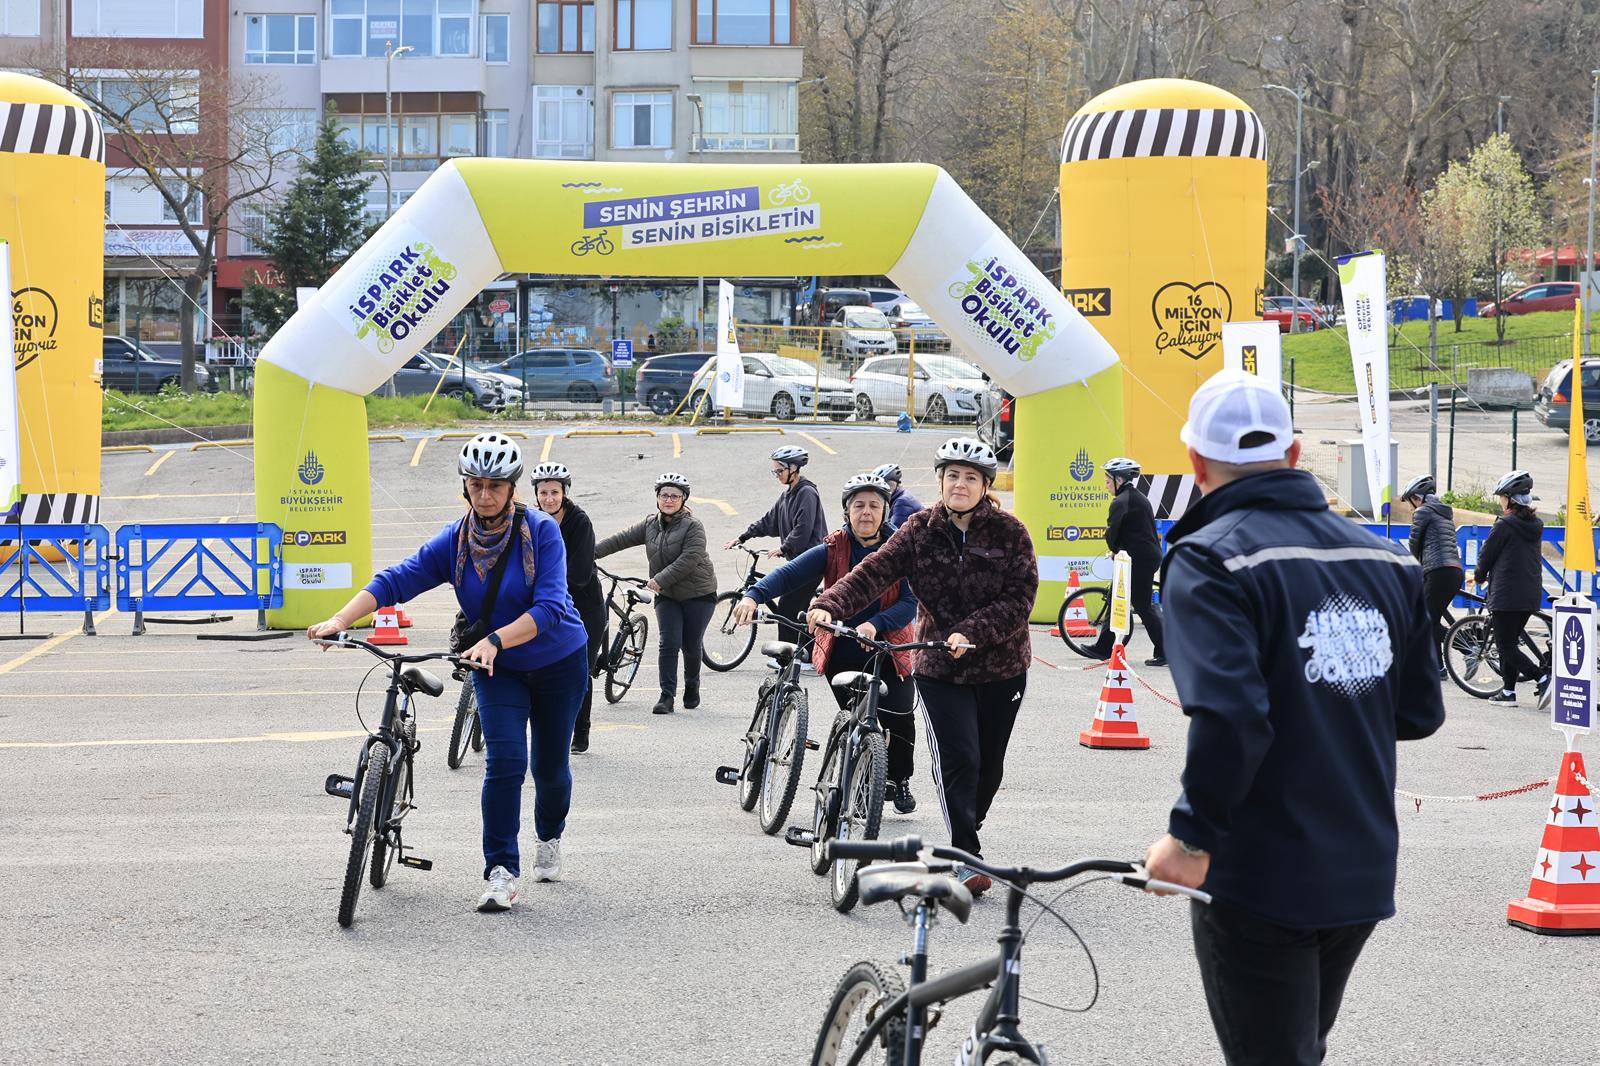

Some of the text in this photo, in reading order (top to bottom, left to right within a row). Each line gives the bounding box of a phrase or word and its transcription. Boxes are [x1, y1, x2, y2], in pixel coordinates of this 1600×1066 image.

[599, 190, 746, 223] SENİN ŞEHRİN
[631, 206, 815, 245] SENİN BİSİKLETİN
[349, 245, 421, 320] İSPARK
[372, 265, 433, 329] Bisiklet
[975, 277, 1035, 338] Bisiklet
[984, 256, 1053, 327] İSPARK
[1187, 294, 1202, 307] 16
[390, 279, 450, 341] Okulu
[961, 294, 1021, 355] Okulu
[280, 495, 343, 506] BÜYÜKŞEHİR
[1050, 491, 1109, 502] BÜYÜKŞEHİR
[284, 531, 344, 545] SPARK
